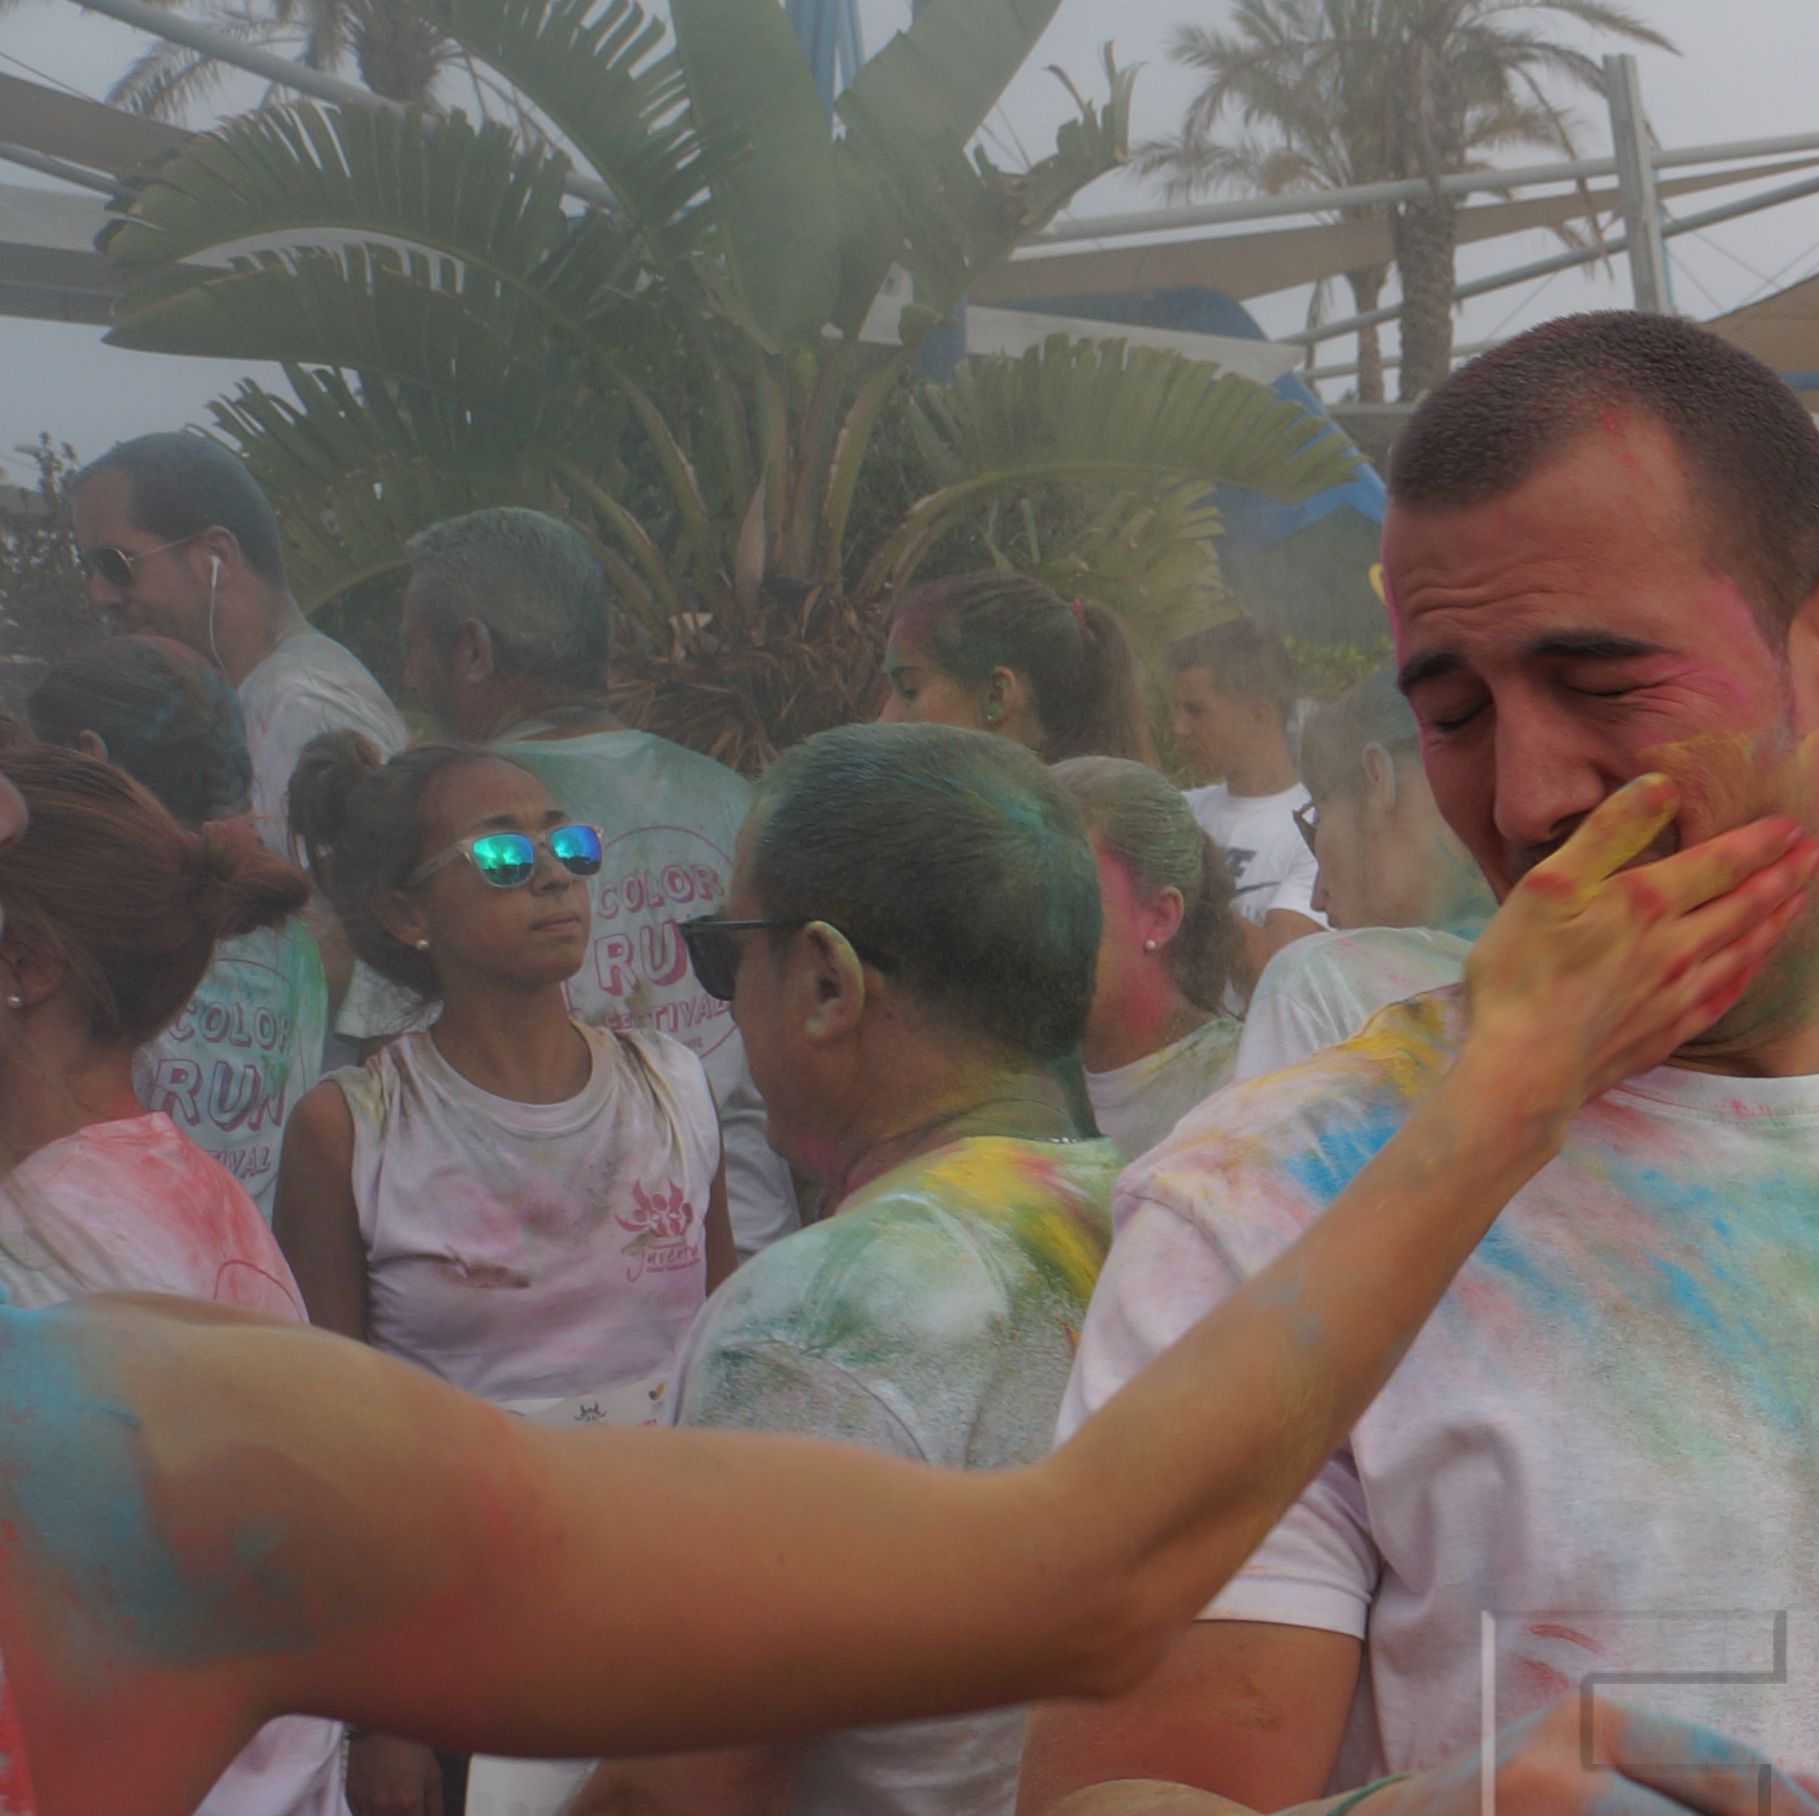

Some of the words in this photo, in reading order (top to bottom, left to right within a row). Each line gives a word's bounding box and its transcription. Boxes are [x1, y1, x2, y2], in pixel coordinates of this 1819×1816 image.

[599, 864, 724, 919] COLOR
[594, 918, 688, 996] RU
[150, 1058, 285, 1132] RUN
